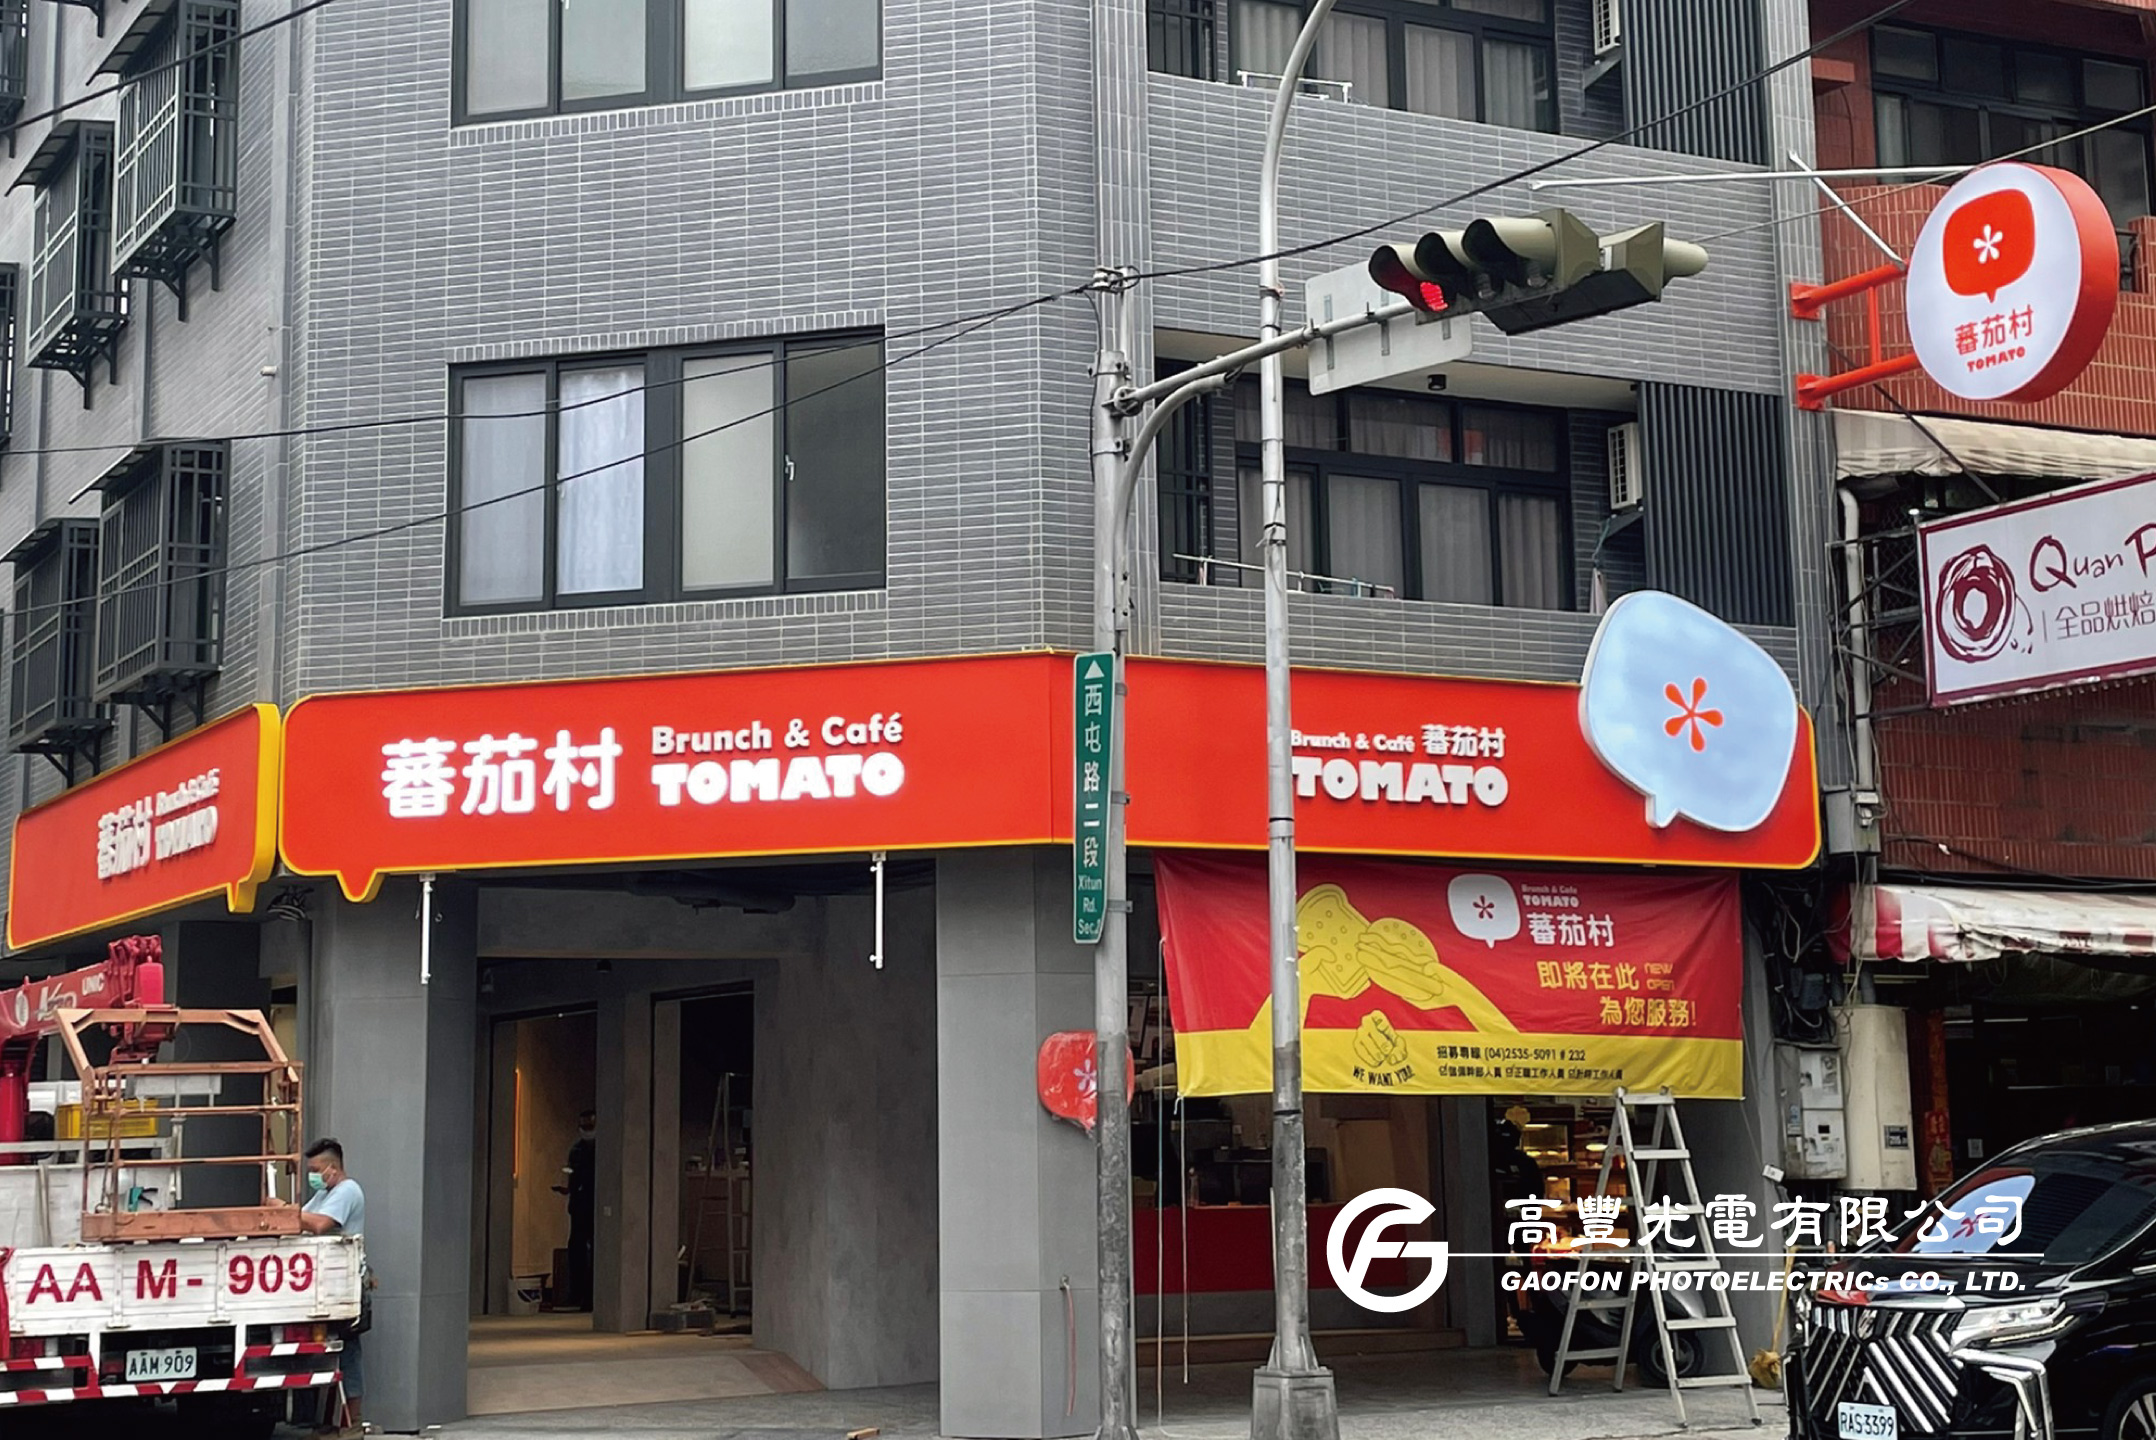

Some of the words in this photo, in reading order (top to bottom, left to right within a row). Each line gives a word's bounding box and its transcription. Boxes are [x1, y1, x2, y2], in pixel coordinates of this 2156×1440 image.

[1954, 304, 2034, 356] 蕃茄村
[1966, 346, 2026, 372] TOMATO
[2030, 535, 2124, 594] Quan
[2055, 590, 2156, 641] 全品烘焙
[651, 720, 772, 756] Brunch
[784, 717, 811, 748] &
[821, 712, 903, 746] Café
[1291, 729, 1352, 750] Brunch
[1354, 733, 1370, 750] &
[1373, 733, 1416, 753] Café
[1420, 724, 1506, 758] 蕃茄村
[380, 726, 624, 819] 蕃茄村
[651, 752, 906, 806] TOMATO
[1082, 683, 1104, 868] 西屯路二段
[1291, 756, 1509, 807] TOMATO
[1077, 874, 1103, 891] Xitun
[1082, 896, 1098, 913] Rd.
[1522, 894, 1580, 908] TOMATO
[1526, 911, 1615, 947] 蕃茄村
[1536, 960, 1640, 991] 即將在此
[1568, 1049, 1586, 1061] 232
[1367, 1071, 1394, 1087] WANT
[228, 1252, 314, 1295] 909
